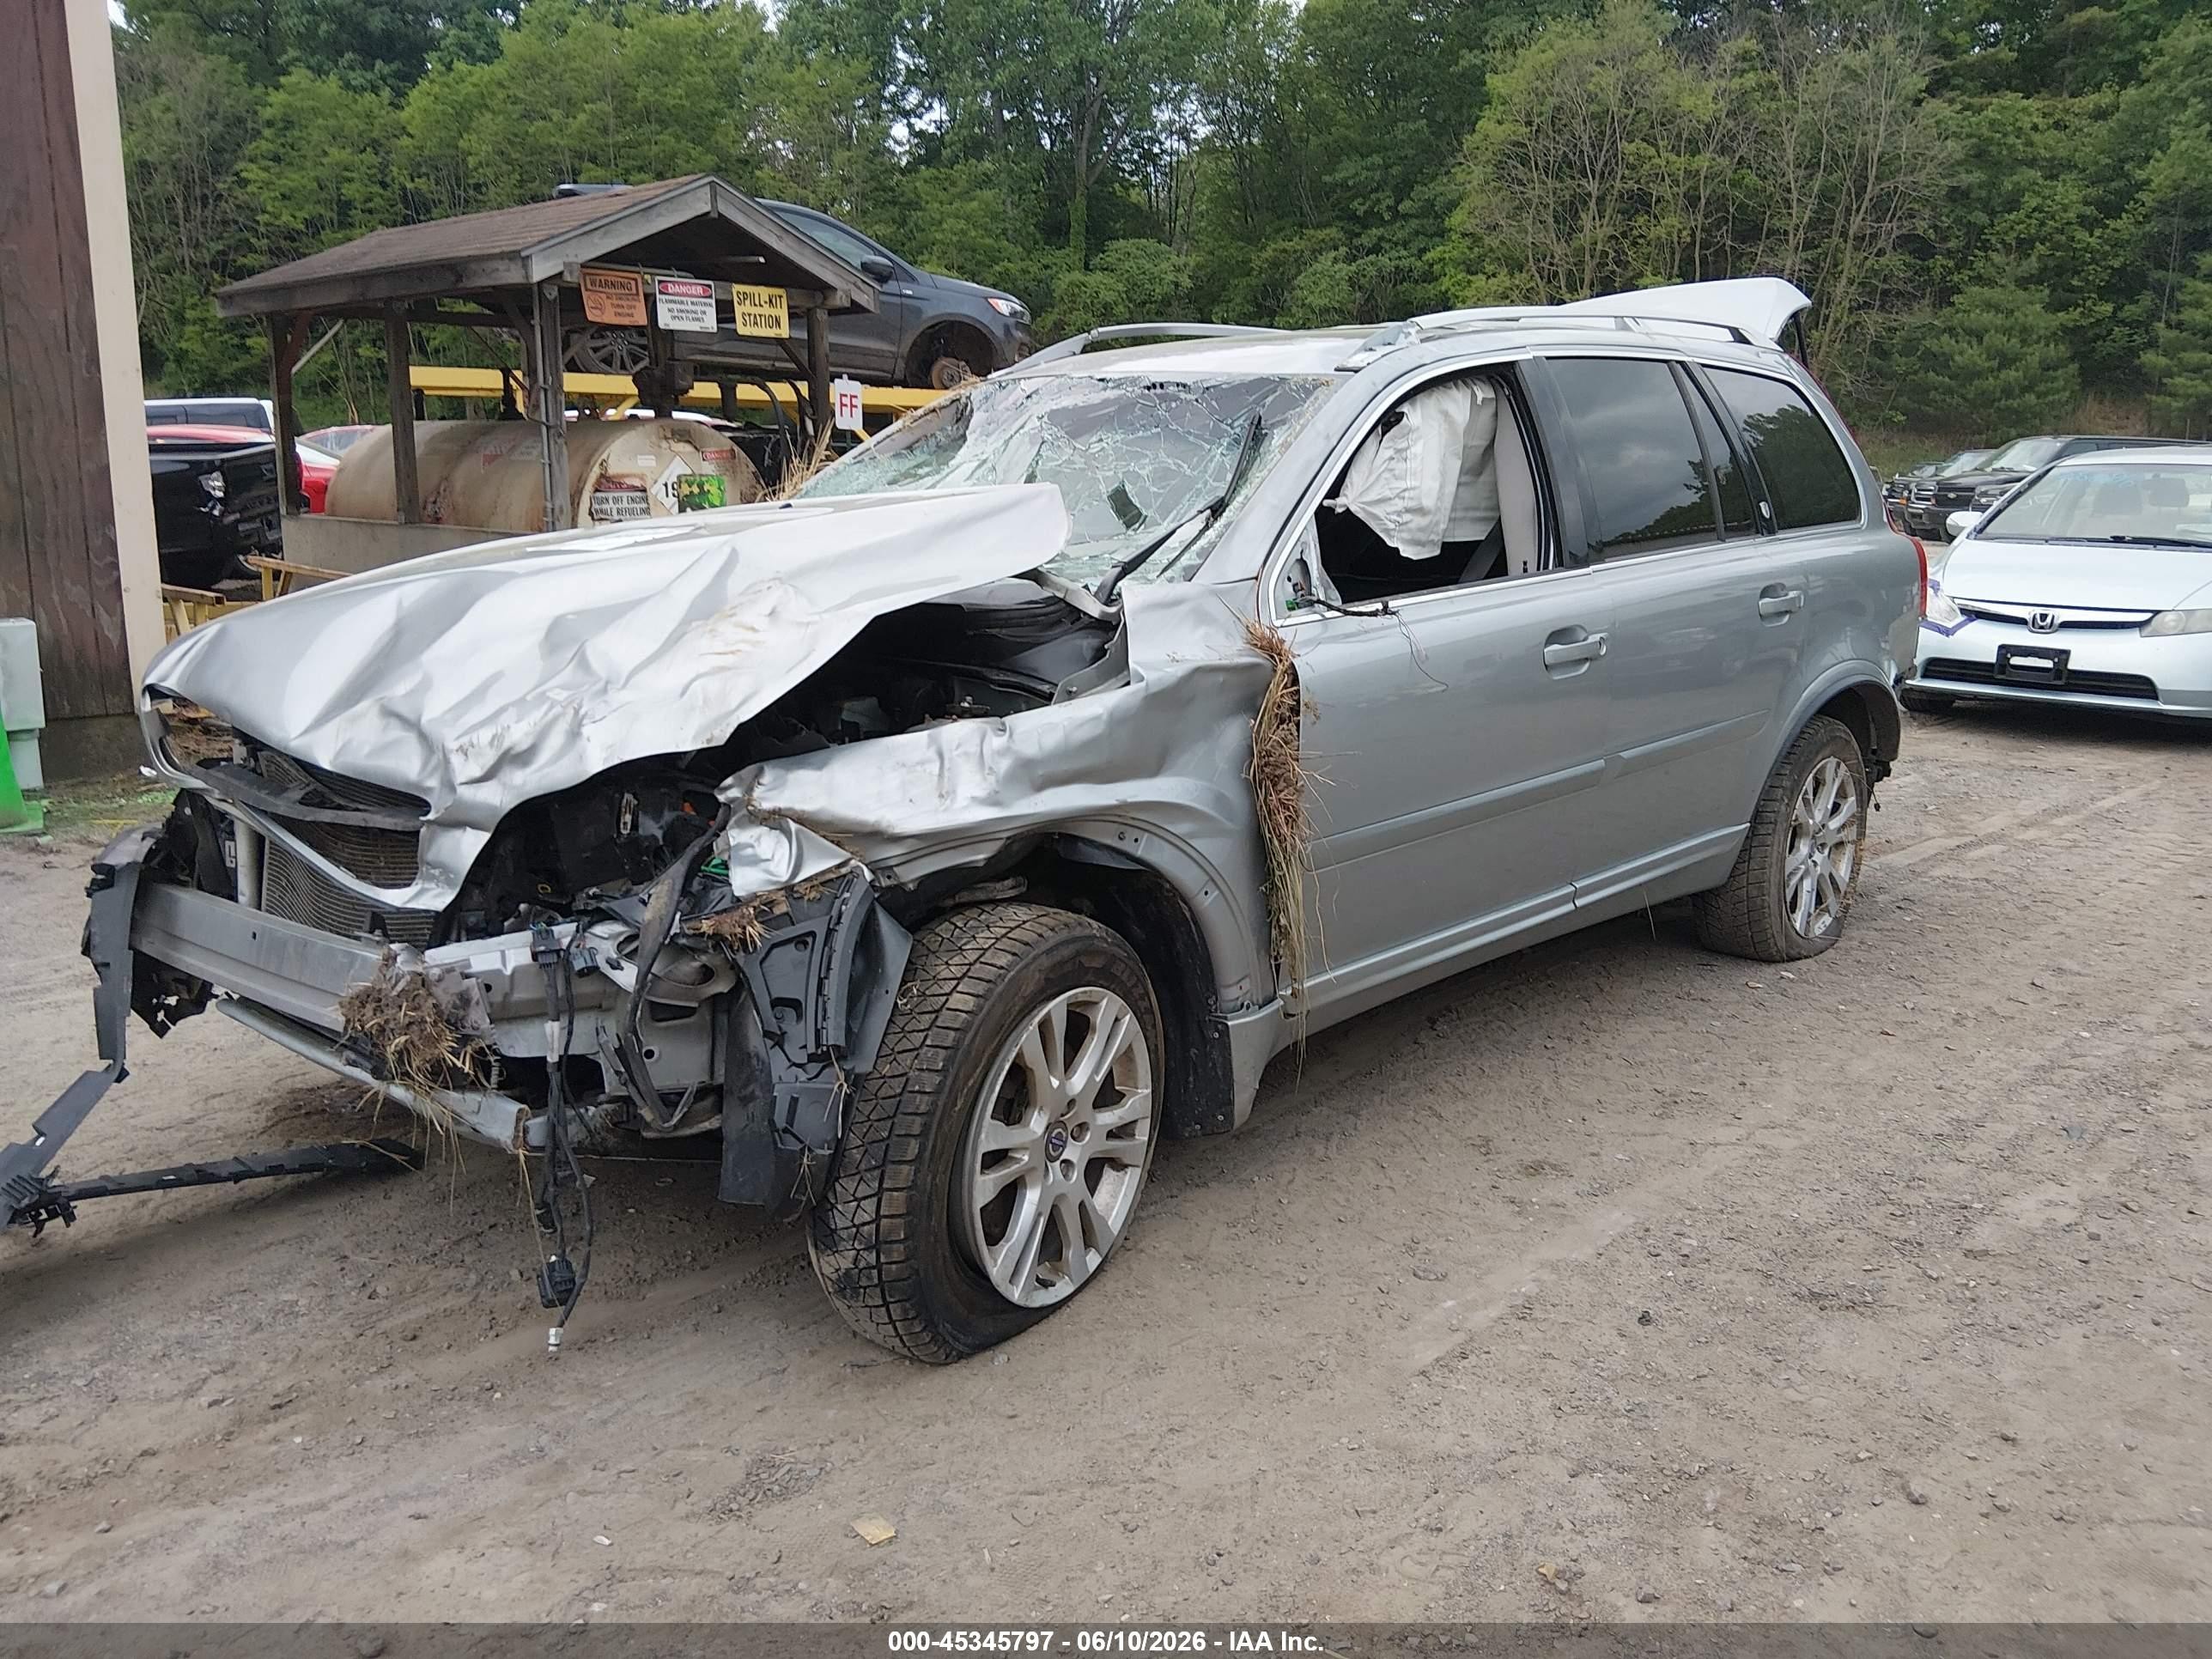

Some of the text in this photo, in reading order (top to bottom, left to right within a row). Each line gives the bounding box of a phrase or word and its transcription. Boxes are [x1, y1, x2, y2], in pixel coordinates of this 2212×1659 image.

[589, 277, 633, 292] WARNING
[668, 283, 703, 296] DANGER
[690, 300, 714, 308] MATERIAL
[736, 290, 783, 310] SPILL-KIT
[741, 312, 781, 330] STATION
[840, 392, 858, 418] FF
[592, 495, 610, 506] TURN
[612, 495, 624, 506] OFF
[593, 507, 652, 517] WHILE REFUELING
